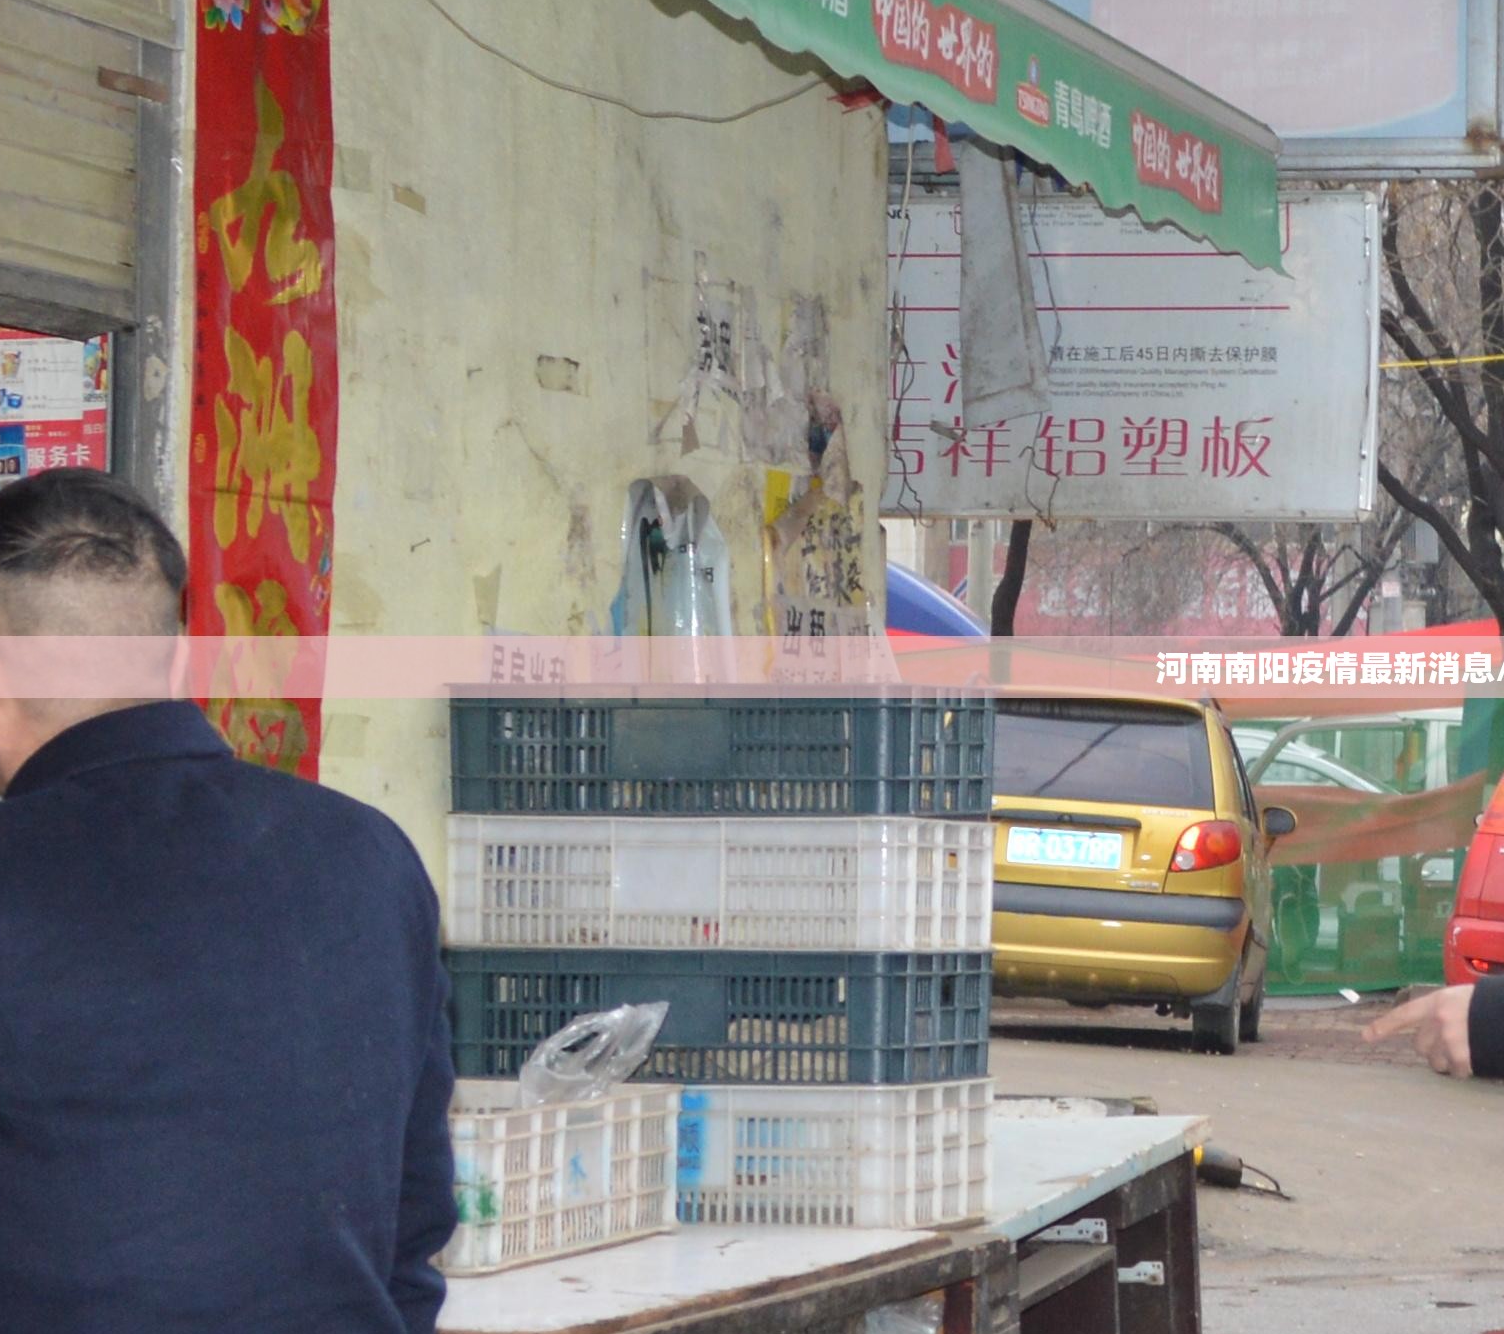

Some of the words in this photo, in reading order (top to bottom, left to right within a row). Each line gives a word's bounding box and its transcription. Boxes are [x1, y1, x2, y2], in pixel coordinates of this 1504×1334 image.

[937, 13, 993, 89] 世界的
[1132, 114, 1170, 177] 中国的
[1175, 141, 1218, 202] 世界的
[27, 444, 91, 469] 服务卡
